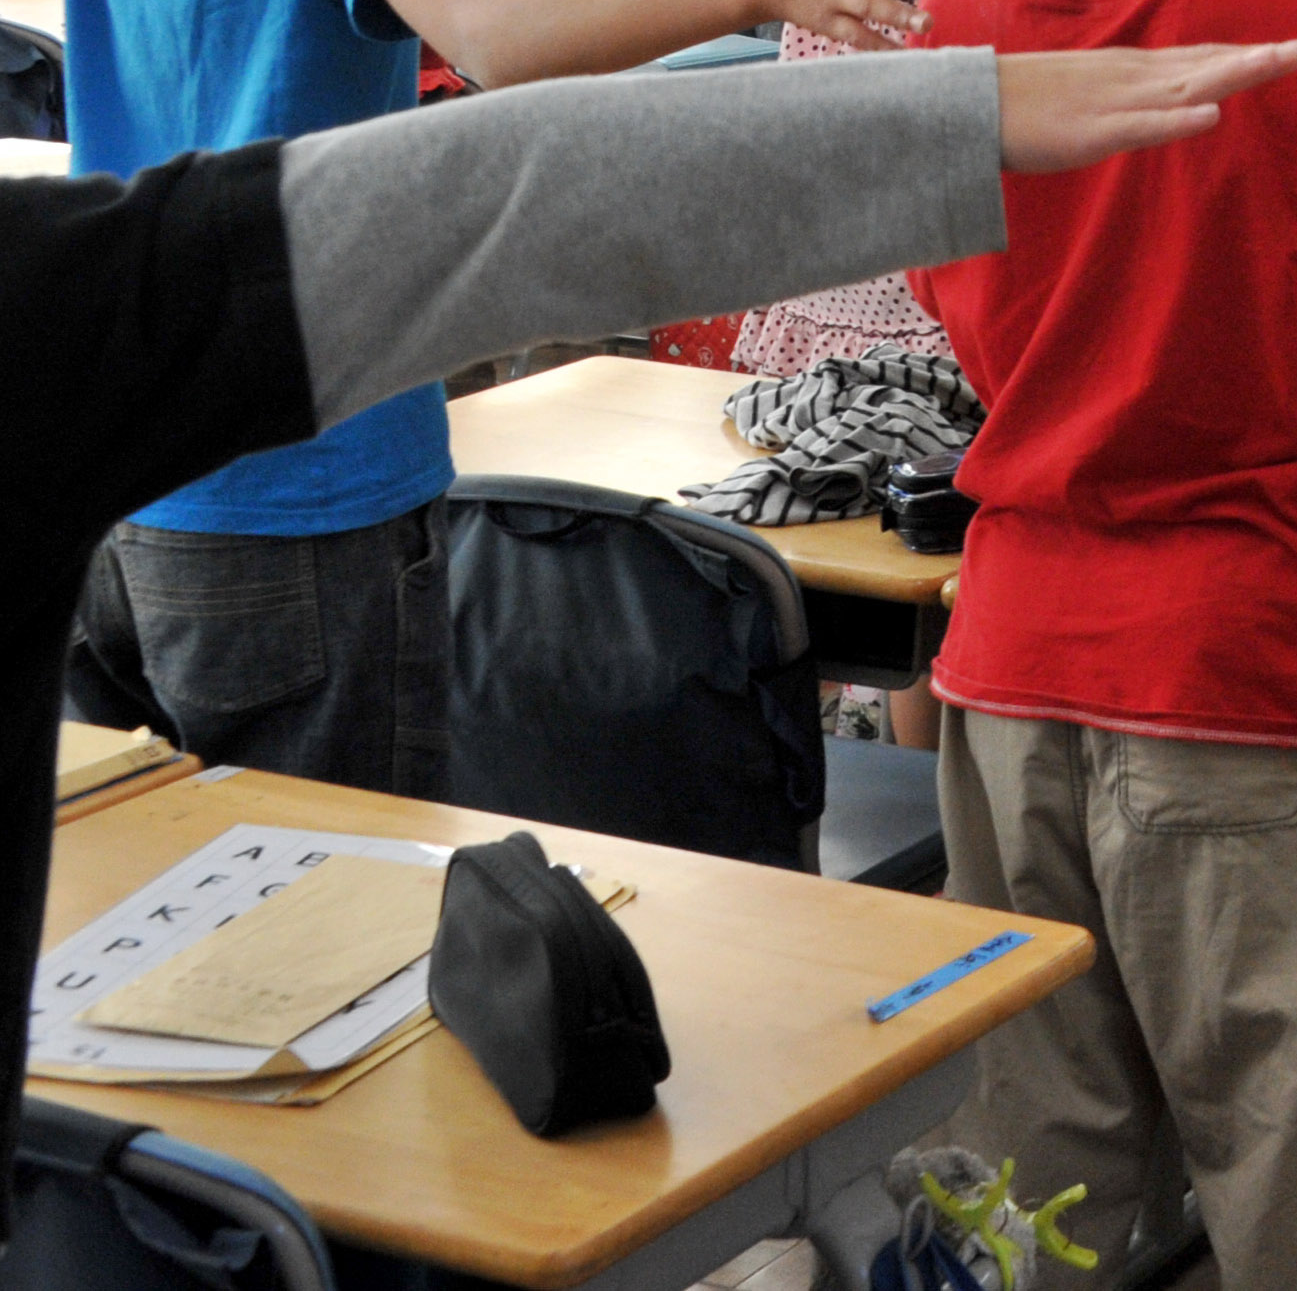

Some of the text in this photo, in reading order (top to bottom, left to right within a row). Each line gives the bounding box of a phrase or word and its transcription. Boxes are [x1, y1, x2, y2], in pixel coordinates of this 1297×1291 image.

[232, 845, 264, 862] A
[194, 873, 231, 890] F
[147, 904, 192, 923] K
[102, 937, 143, 955] P
[56, 971, 97, 990] U
